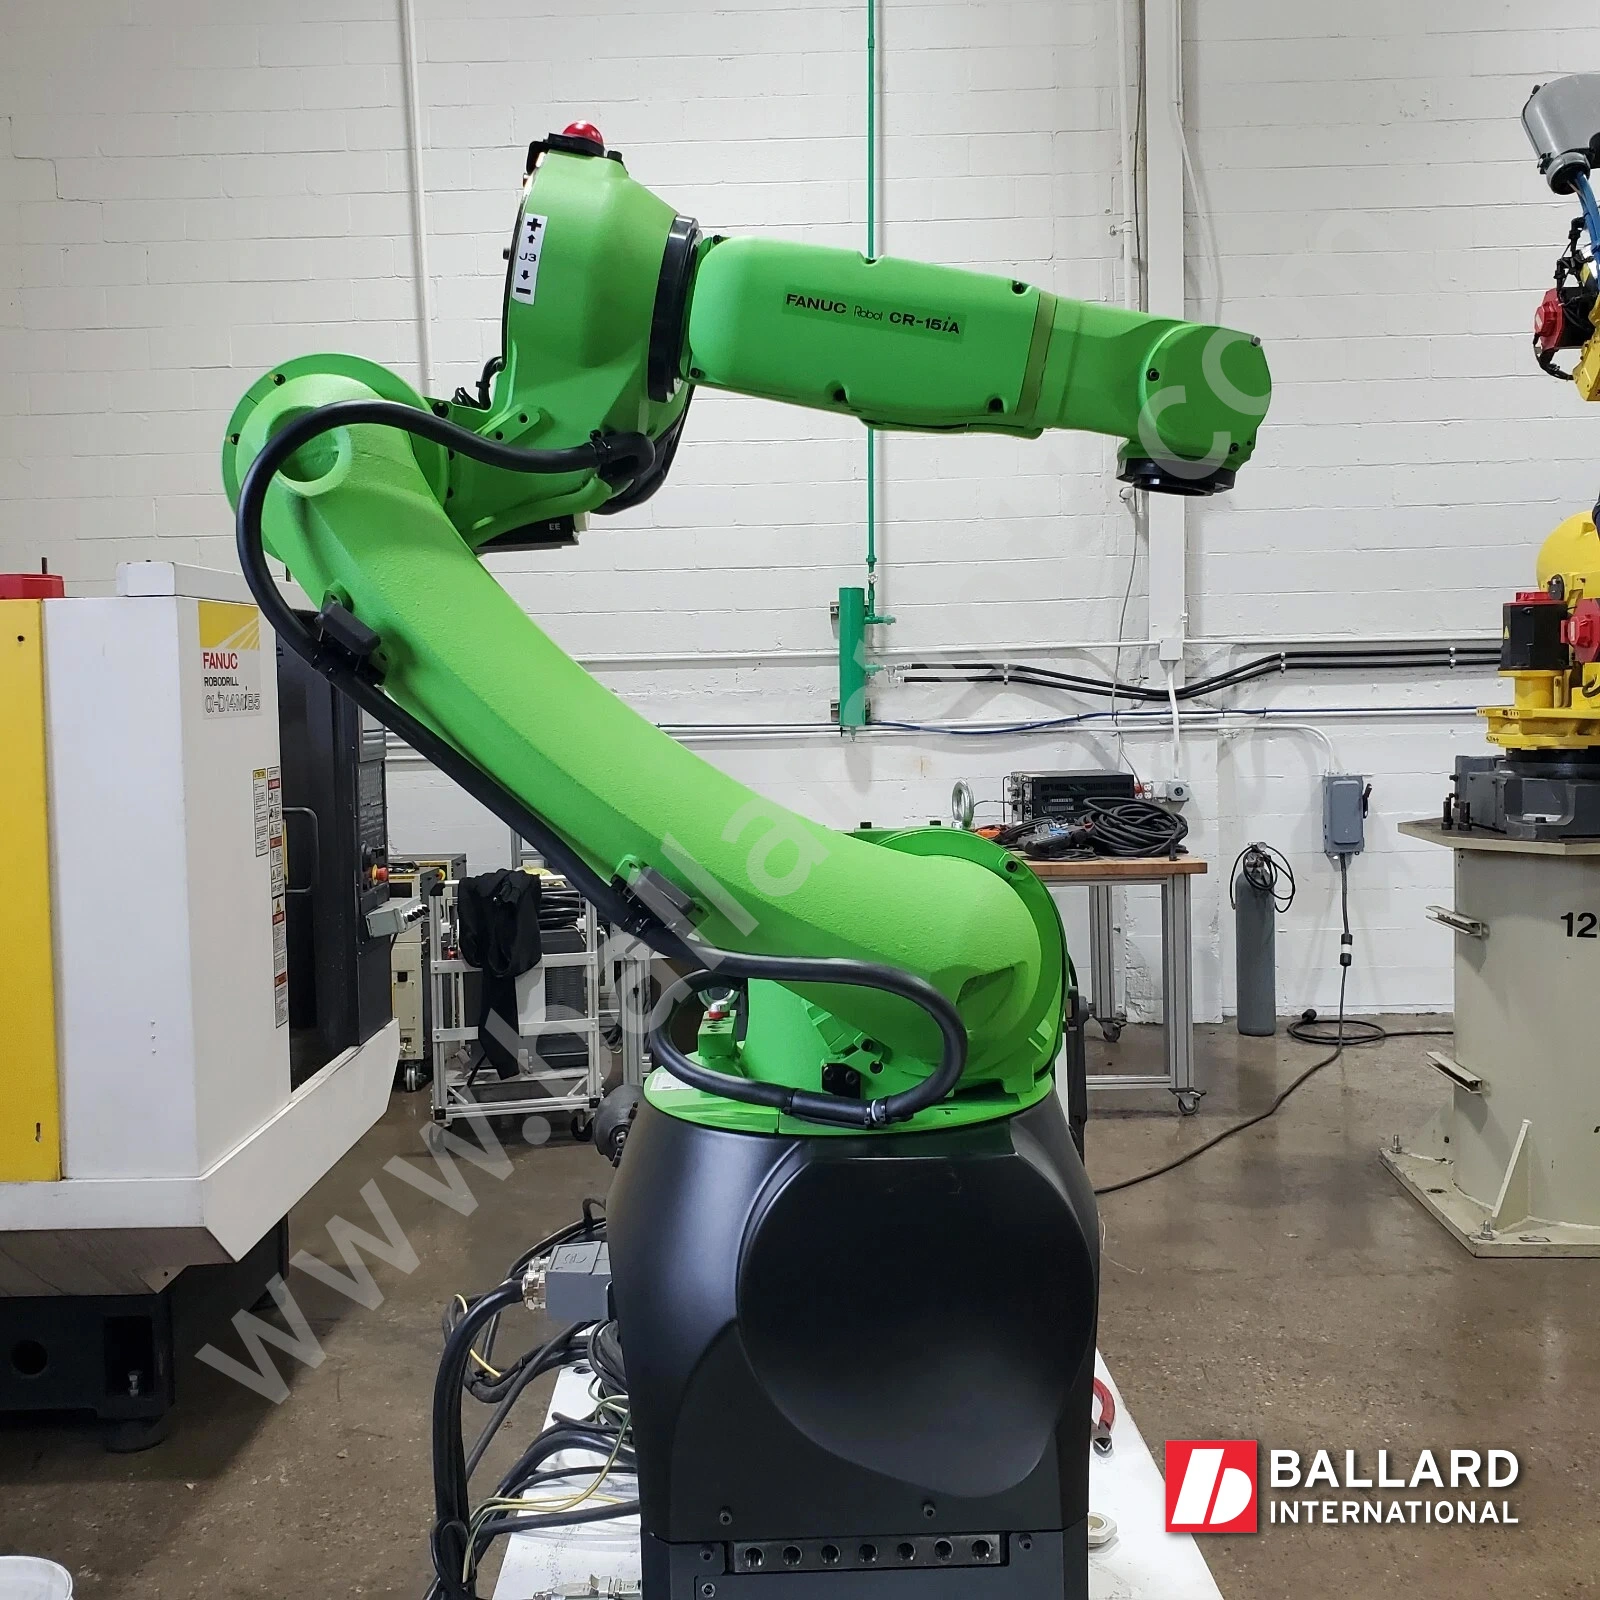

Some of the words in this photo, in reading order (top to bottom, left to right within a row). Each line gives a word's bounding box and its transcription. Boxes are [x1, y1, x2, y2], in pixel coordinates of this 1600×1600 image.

[518, 252, 537, 263] J3
[786, 293, 847, 314] FANUC
[854, 305, 884, 321] Robot
[889, 312, 960, 334] CR-15iA
[549, 522, 561, 531] EE
[202, 652, 238, 670] FANUC
[204, 676, 239, 687] ROBODRILL
[1560, 911, 1600, 938] 12
